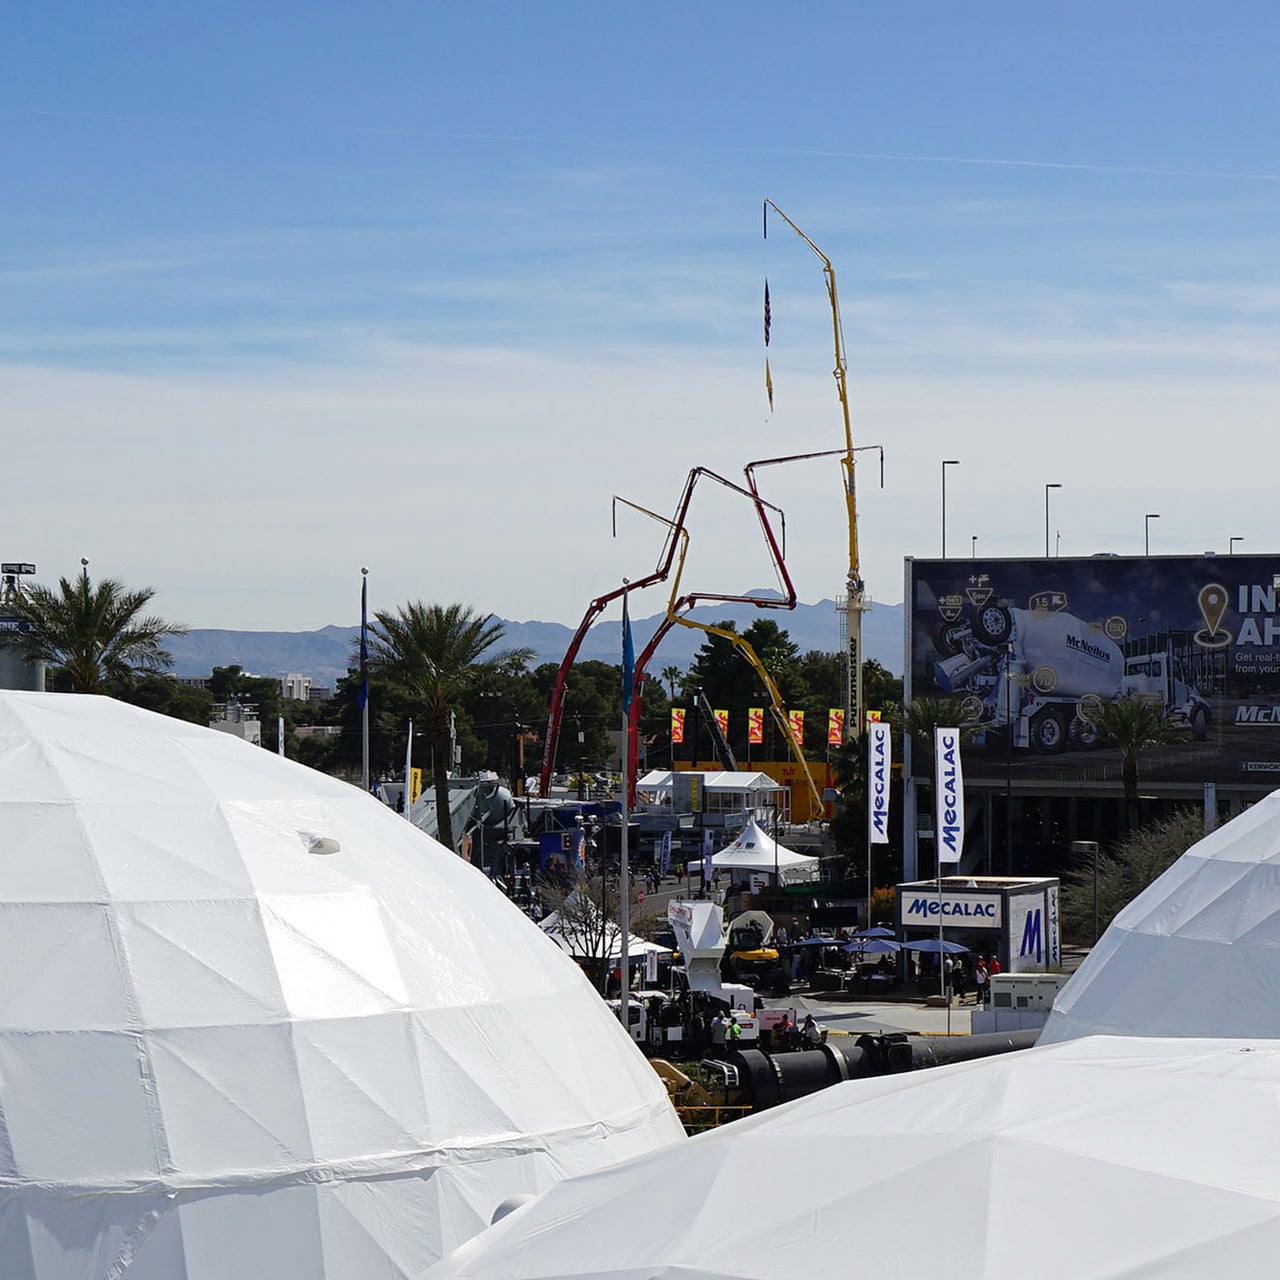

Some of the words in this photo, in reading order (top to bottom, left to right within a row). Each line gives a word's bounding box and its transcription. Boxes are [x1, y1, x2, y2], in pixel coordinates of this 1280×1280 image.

[1066, 634, 1111, 661] McNeilus
[1235, 652, 1252, 662] Get
[1234, 664, 1256, 673] from
[1259, 665, 1280, 675] your
